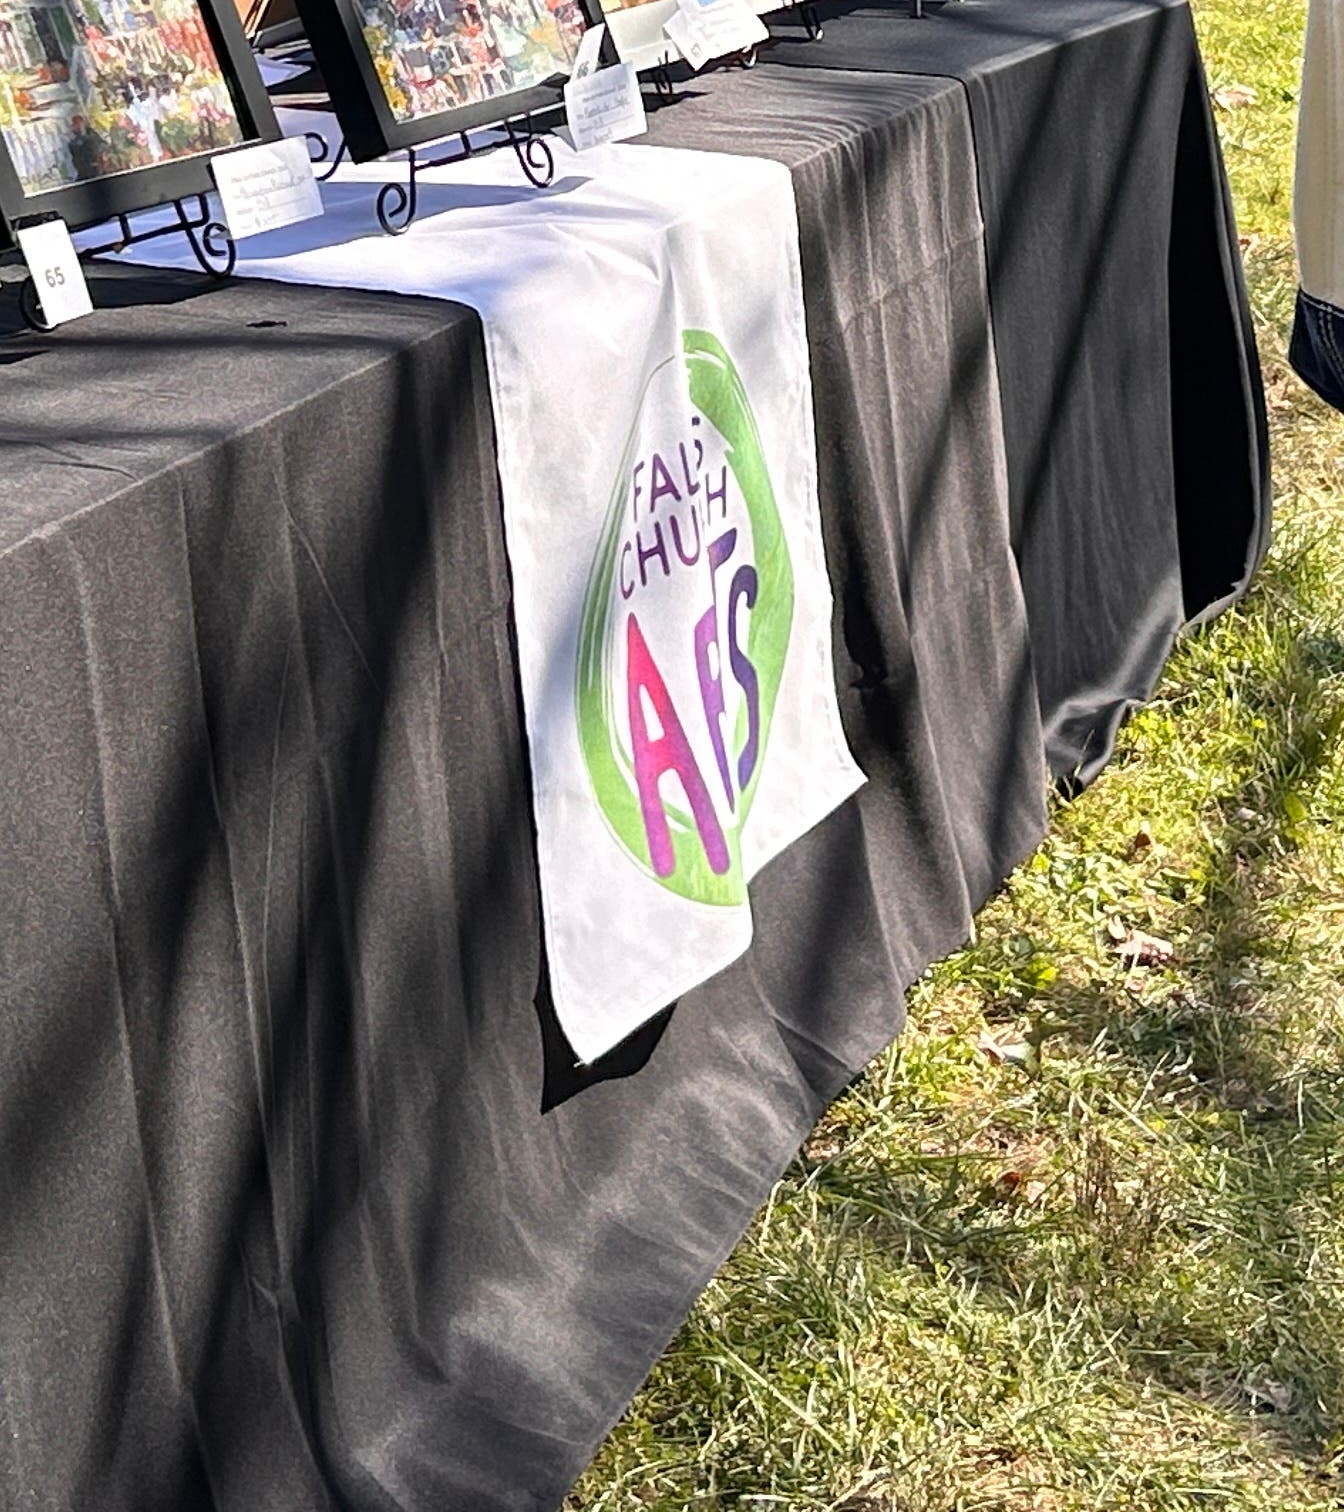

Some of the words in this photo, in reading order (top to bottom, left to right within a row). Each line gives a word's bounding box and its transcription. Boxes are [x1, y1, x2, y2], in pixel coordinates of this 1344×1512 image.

[45, 266, 65, 288] 65
[632, 416, 704, 522] FAL
[620, 465, 727, 600] CHUH
